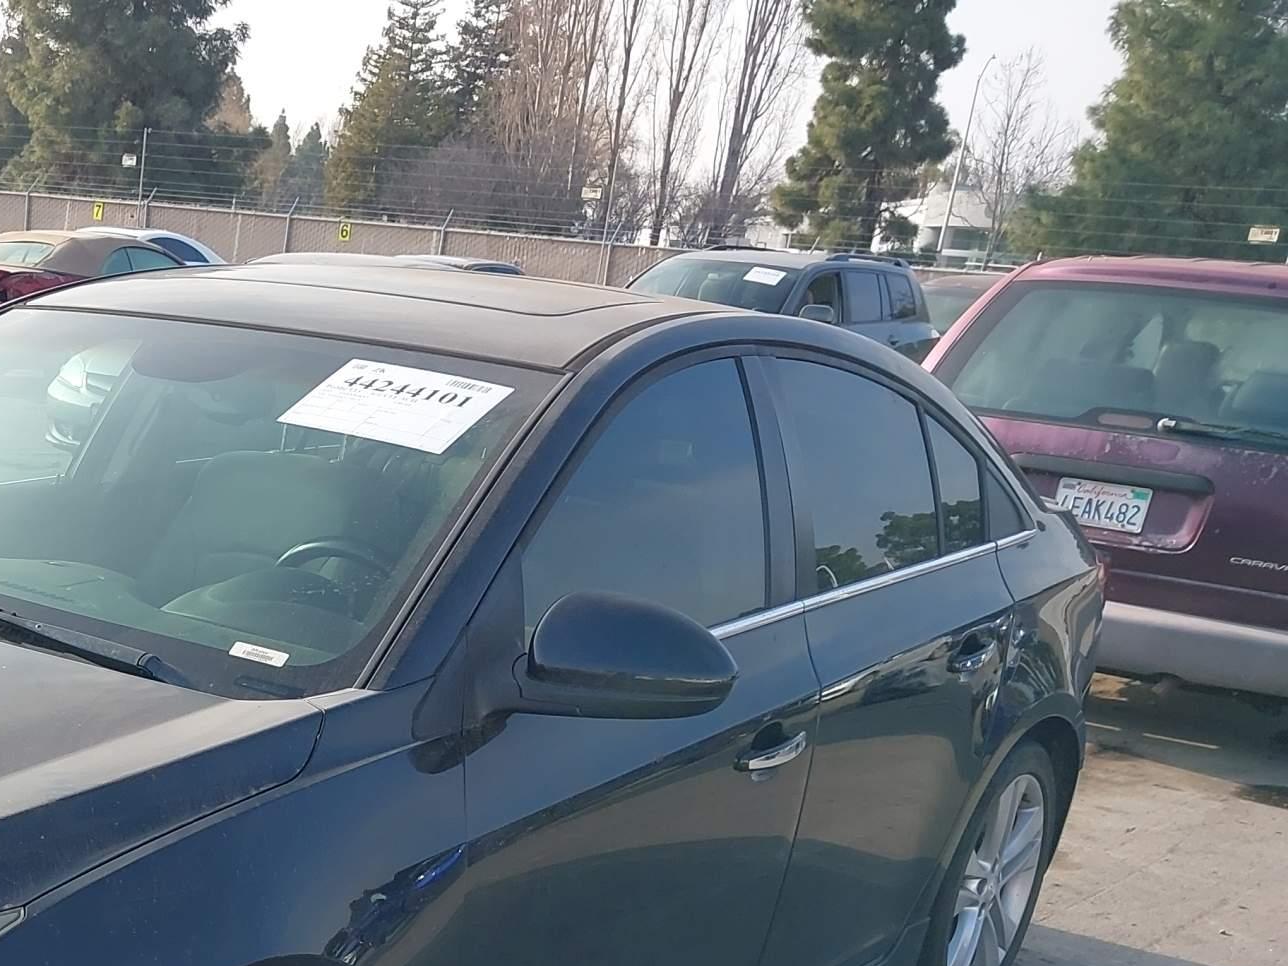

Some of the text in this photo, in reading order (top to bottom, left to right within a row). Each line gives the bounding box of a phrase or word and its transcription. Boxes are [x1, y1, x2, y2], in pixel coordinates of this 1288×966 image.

[95, 204, 102, 218] 7
[340, 224, 349, 239] 6
[344, 375, 473, 407] 44244101
